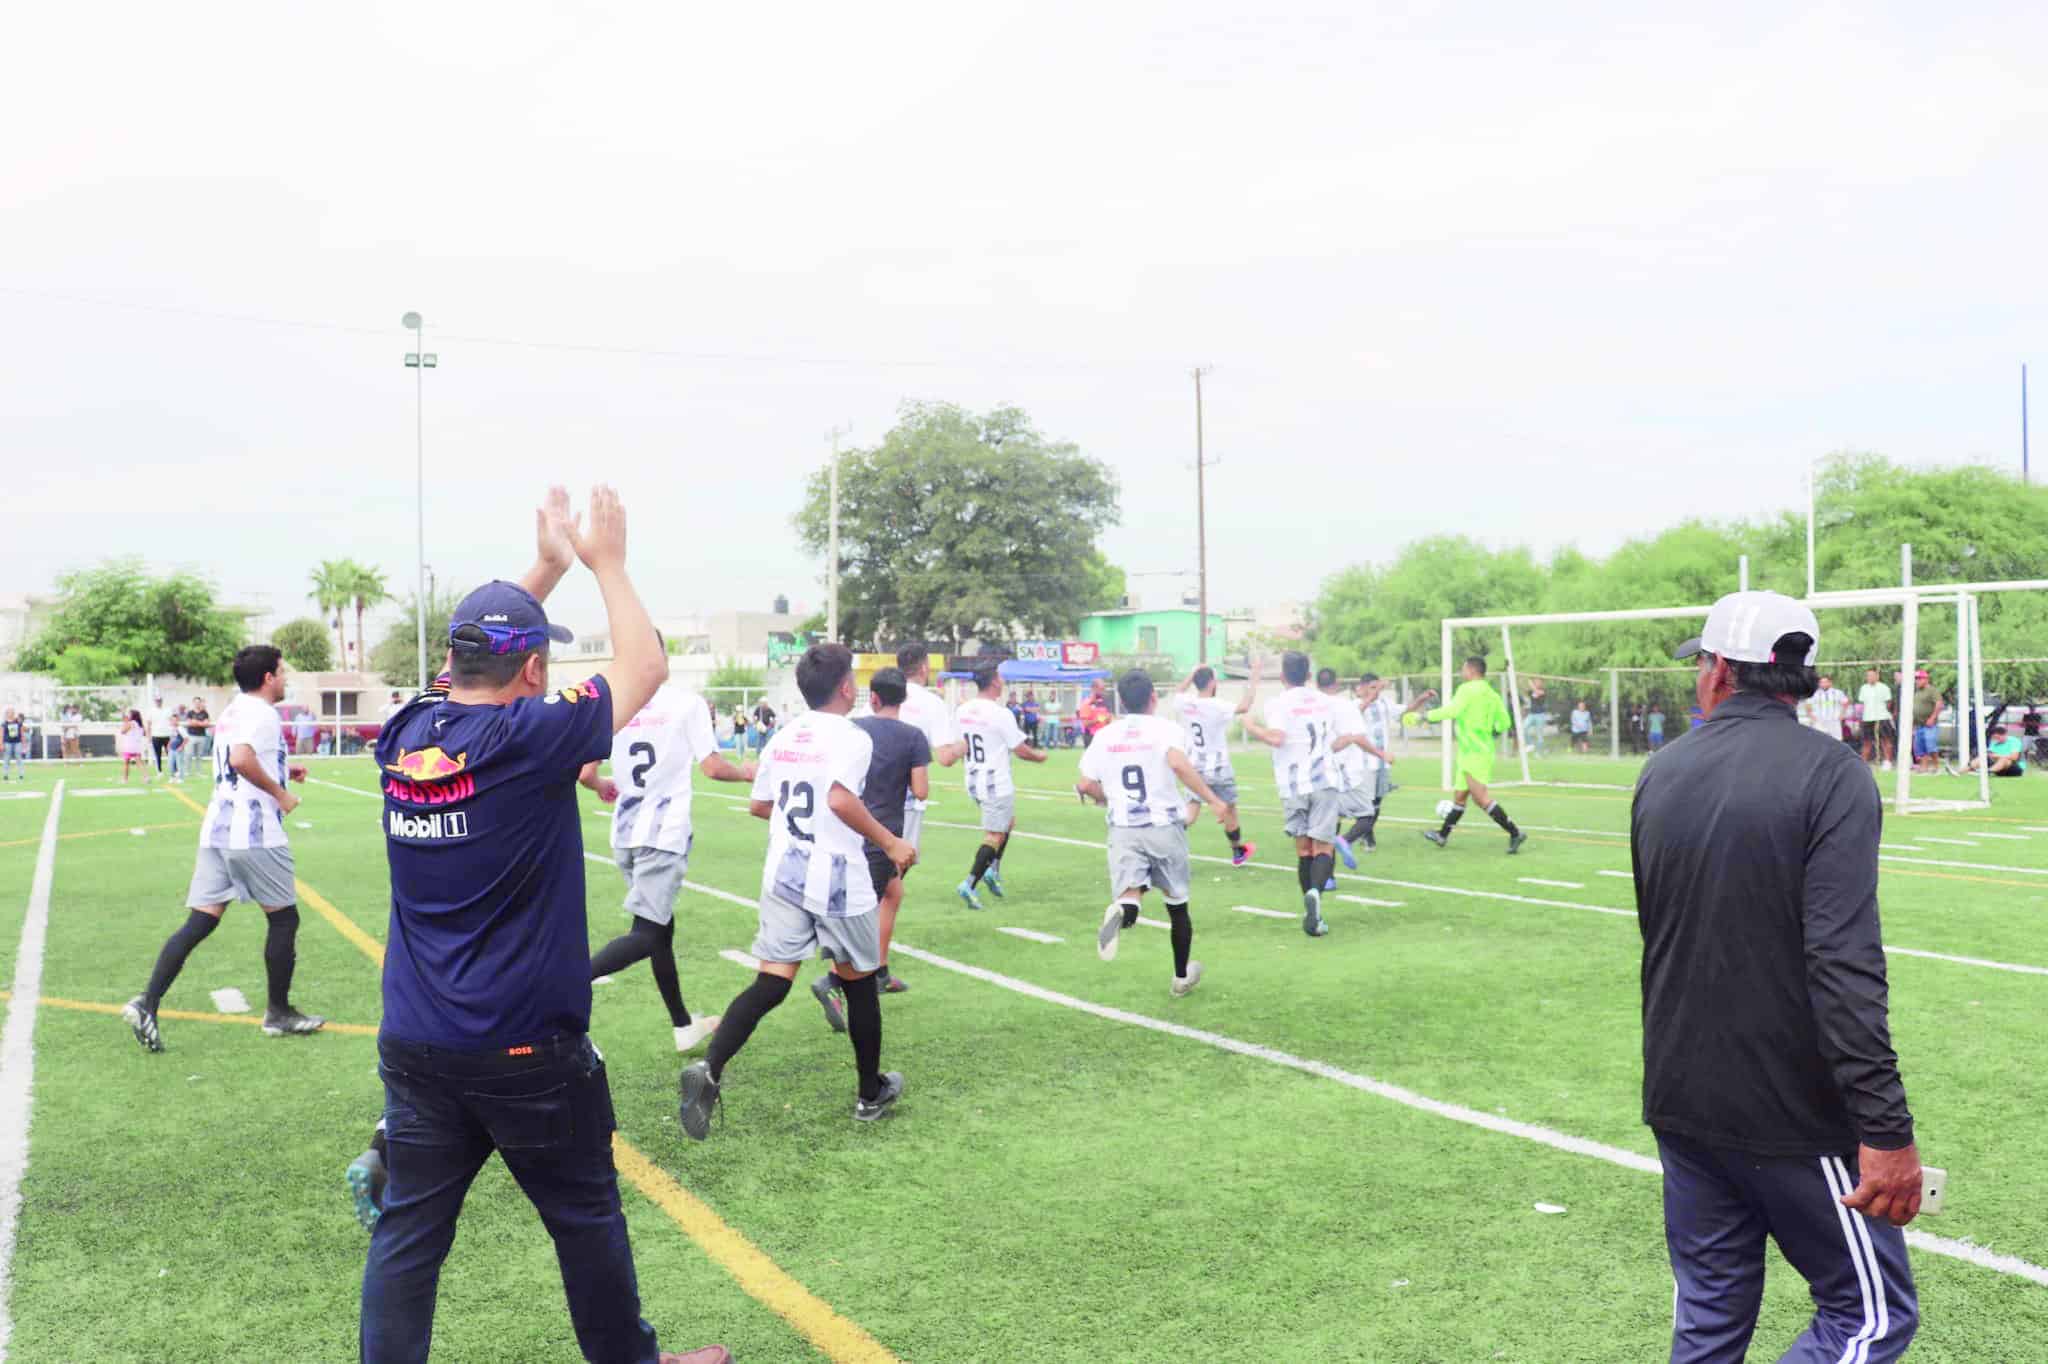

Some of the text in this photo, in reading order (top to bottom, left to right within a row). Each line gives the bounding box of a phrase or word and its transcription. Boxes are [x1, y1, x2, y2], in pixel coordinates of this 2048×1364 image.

[963, 732, 985, 763] 16
[1191, 722, 1205, 747] 3
[629, 741, 656, 788] 2
[1122, 764, 1147, 803] 9
[390, 810, 442, 838] Mobil
[778, 780, 815, 844] 12
